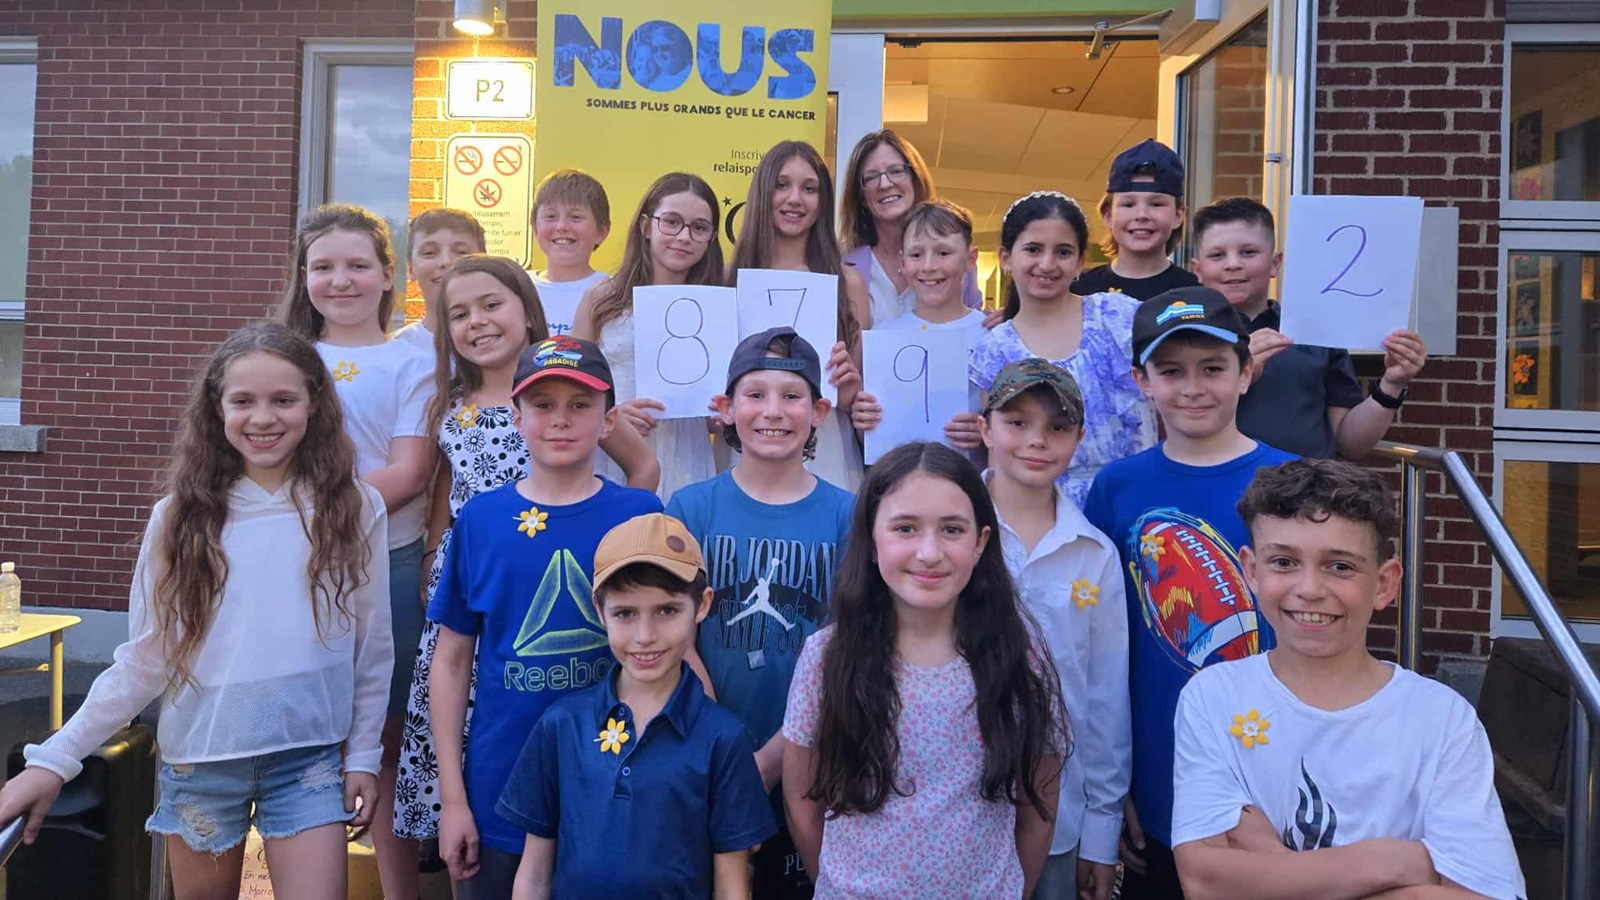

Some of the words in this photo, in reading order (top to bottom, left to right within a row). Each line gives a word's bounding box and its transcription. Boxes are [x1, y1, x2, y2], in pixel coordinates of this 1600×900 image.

[476, 79, 505, 102] P2
[553, 14, 816, 99] NOUS
[586, 98, 637, 110] SOMMES
[641, 101, 669, 112] PLUS
[674, 103, 721, 115] GRANDS
[726, 106, 748, 118] QUE
[752, 108, 765, 118] LE
[768, 109, 816, 121] CANCER
[1320, 224, 1384, 297] 2
[656, 297, 711, 386] 8
[767, 287, 808, 330] 7
[893, 344, 930, 424] 9
